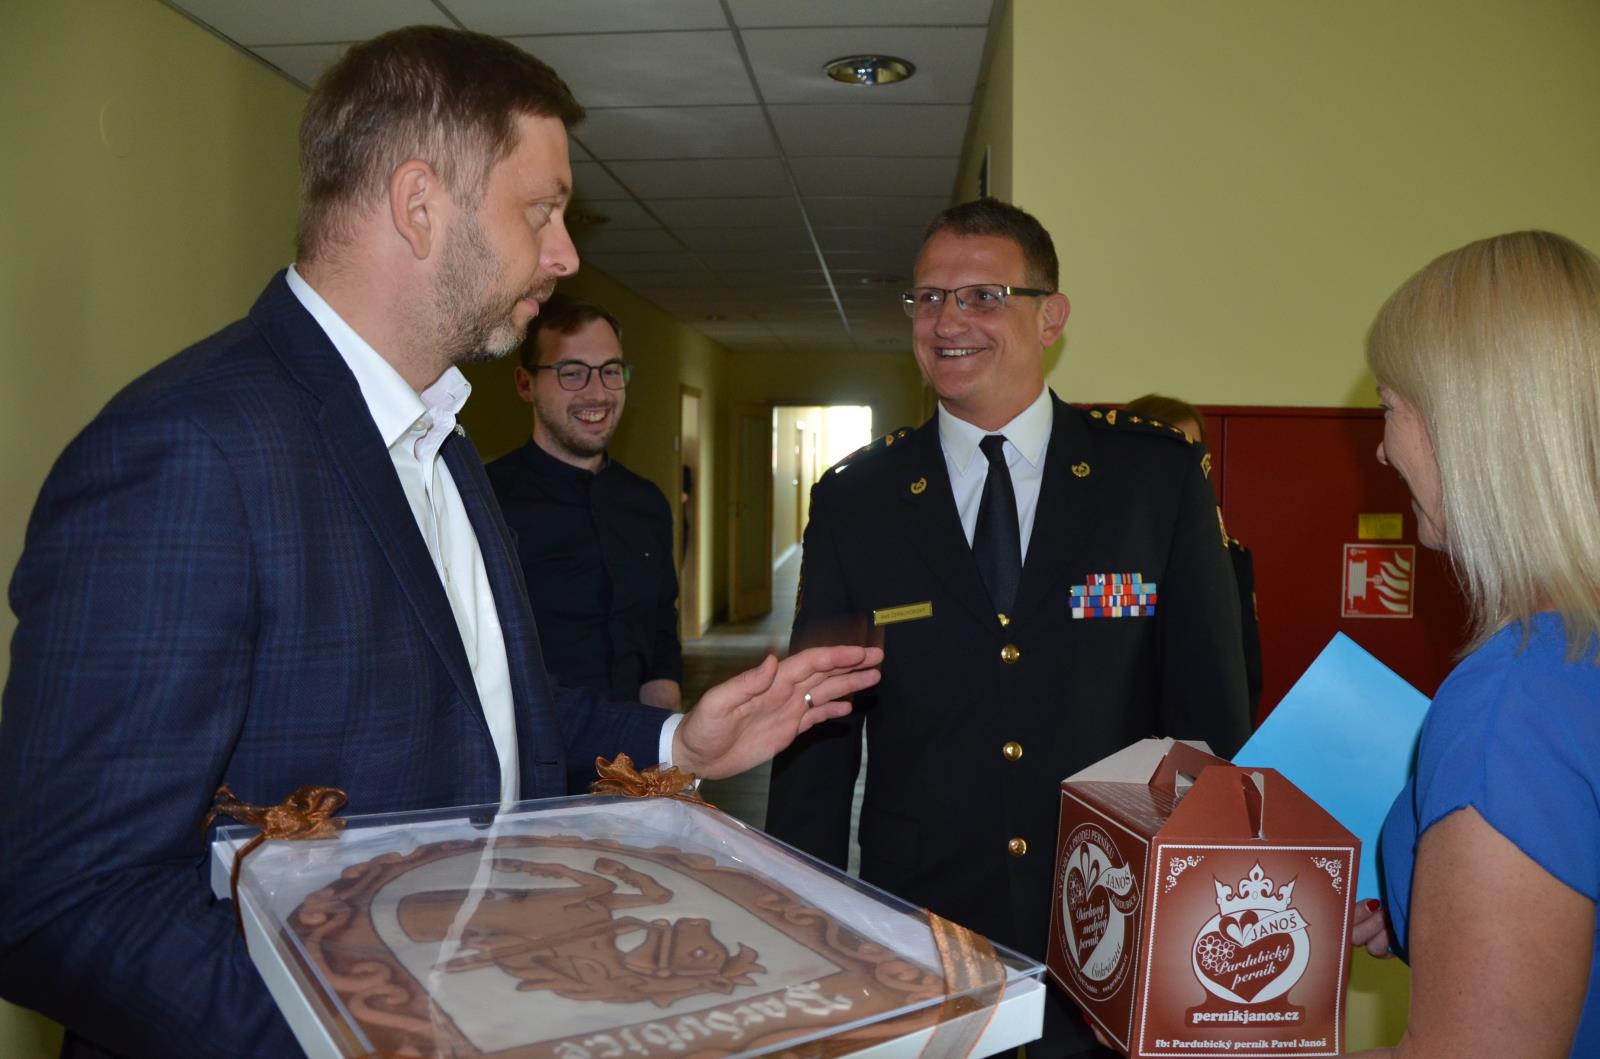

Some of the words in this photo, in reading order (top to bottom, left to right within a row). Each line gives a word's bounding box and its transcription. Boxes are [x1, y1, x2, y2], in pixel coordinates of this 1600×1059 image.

[1072, 829, 1090, 848] PRODEJ
[1106, 870, 1130, 890] JANOŠ
[1251, 912, 1298, 941] JANOŠ
[1214, 943, 1290, 976] Pardubický
[1231, 962, 1277, 990] perník
[1192, 1010, 1300, 1025] pernikjanos.cz
[1155, 1039, 1170, 1049] fb:
[1172, 1039, 1232, 1050] Pardubický
[1271, 1039, 1297, 1048] Pavel
[1298, 1038, 1327, 1048] Janoš
